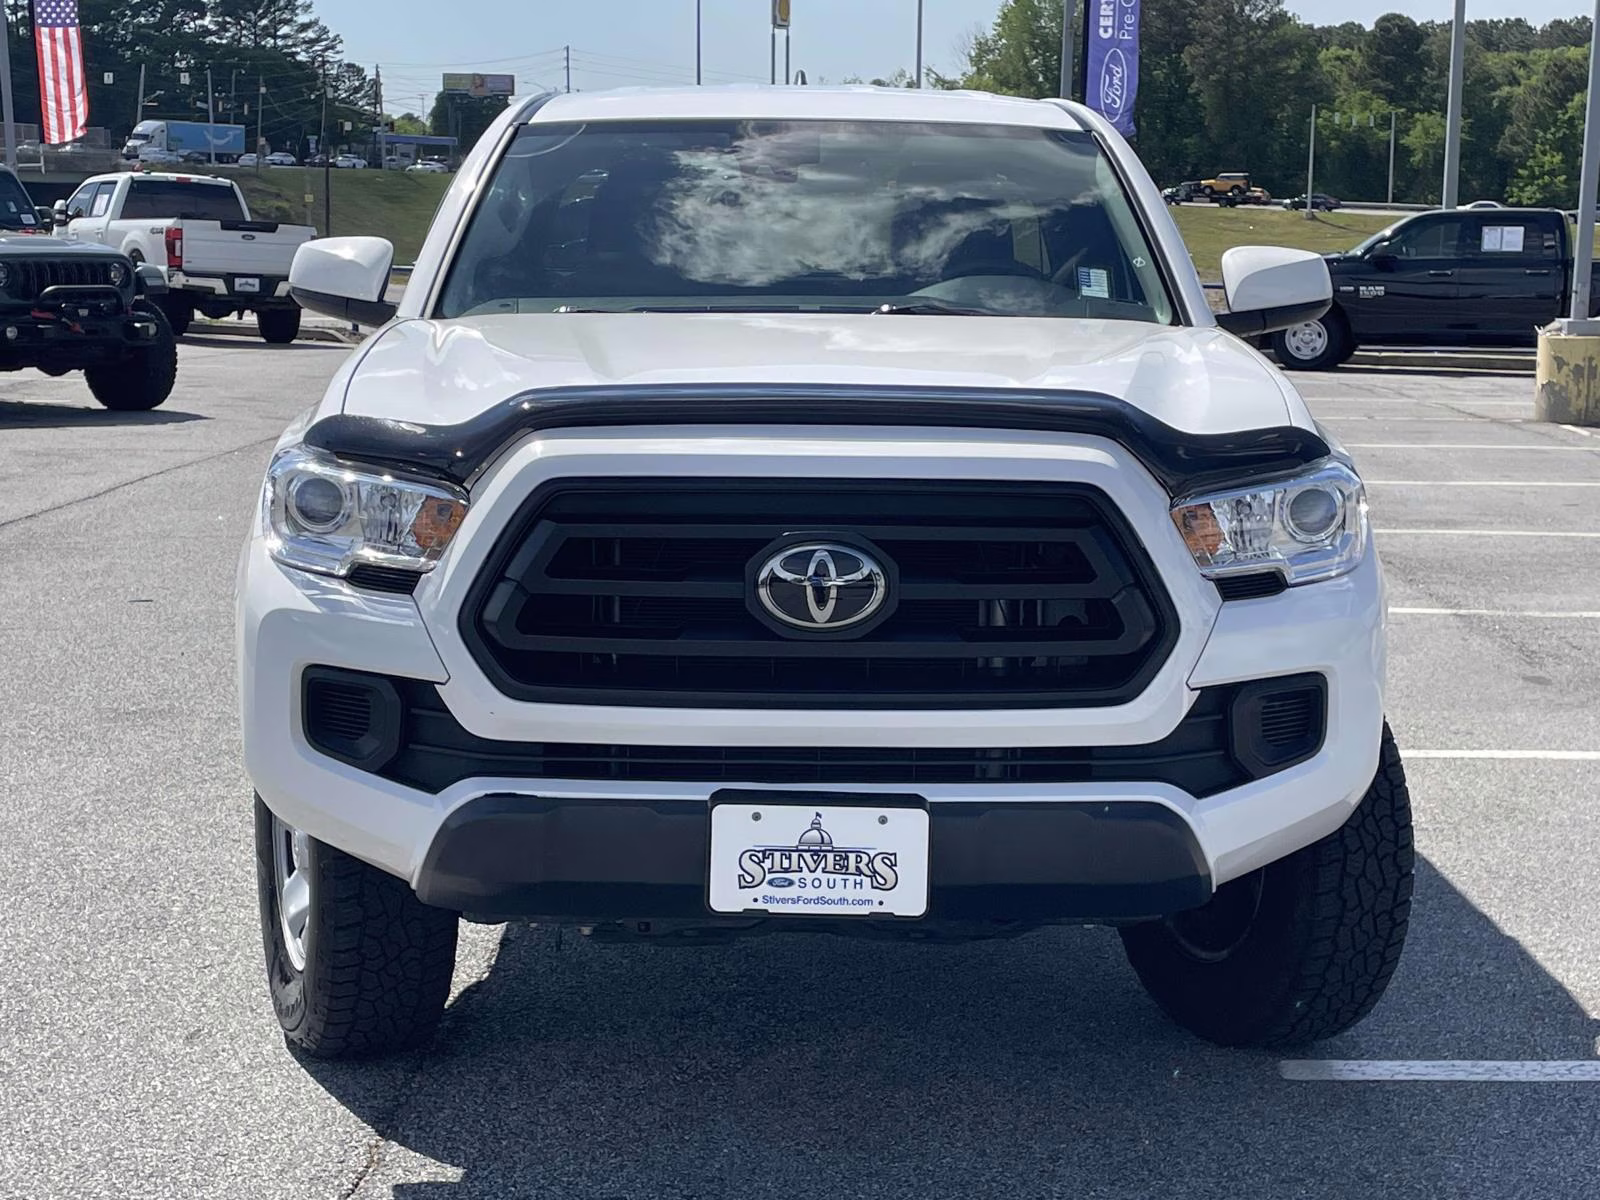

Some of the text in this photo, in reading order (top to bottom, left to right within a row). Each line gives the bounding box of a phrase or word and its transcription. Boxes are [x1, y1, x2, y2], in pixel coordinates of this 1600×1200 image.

[1103, 63, 1123, 109] Ford
[738, 848, 899, 891] STIVERS
[797, 877, 864, 890] SOUTH
[761, 894, 874, 907] StiversFordSouth.com
